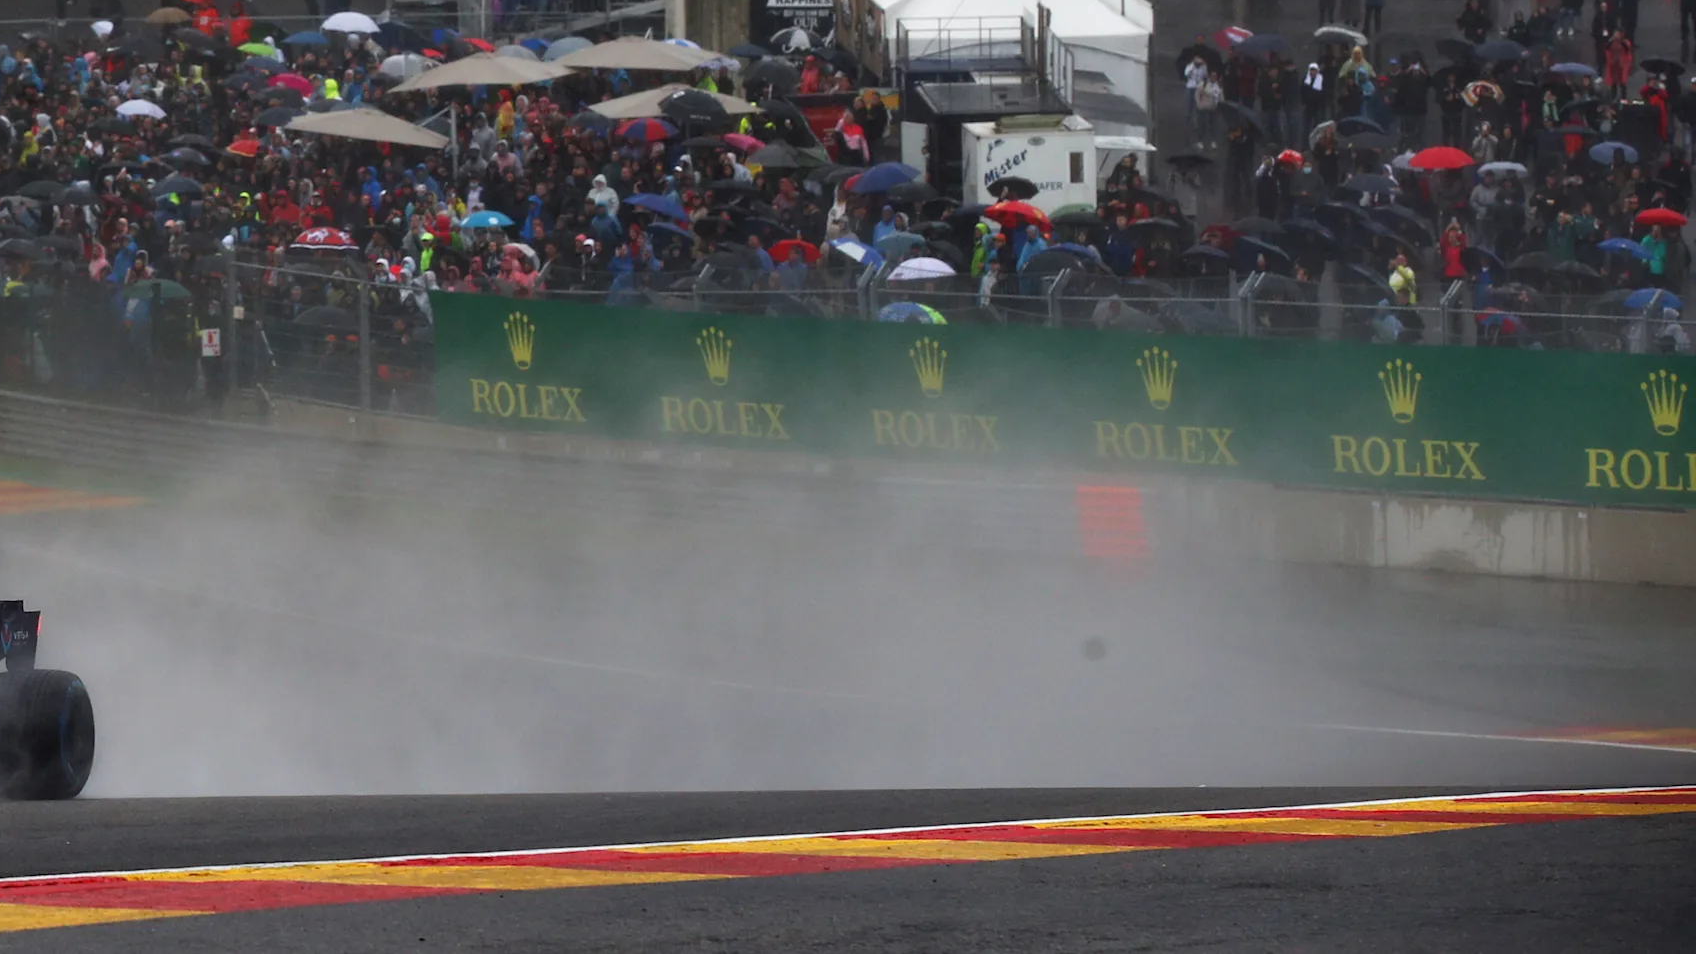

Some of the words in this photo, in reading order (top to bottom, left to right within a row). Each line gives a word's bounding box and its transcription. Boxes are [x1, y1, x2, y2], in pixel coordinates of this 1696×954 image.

[794, 17, 819, 30] OUR
[984, 149, 1028, 185] Mister
[469, 378, 587, 423] ROLEX
[660, 396, 791, 440] ROLEX
[871, 409, 1000, 451] ROLEX
[1092, 420, 1240, 467] ROLEX
[1331, 434, 1487, 481] ROLEX
